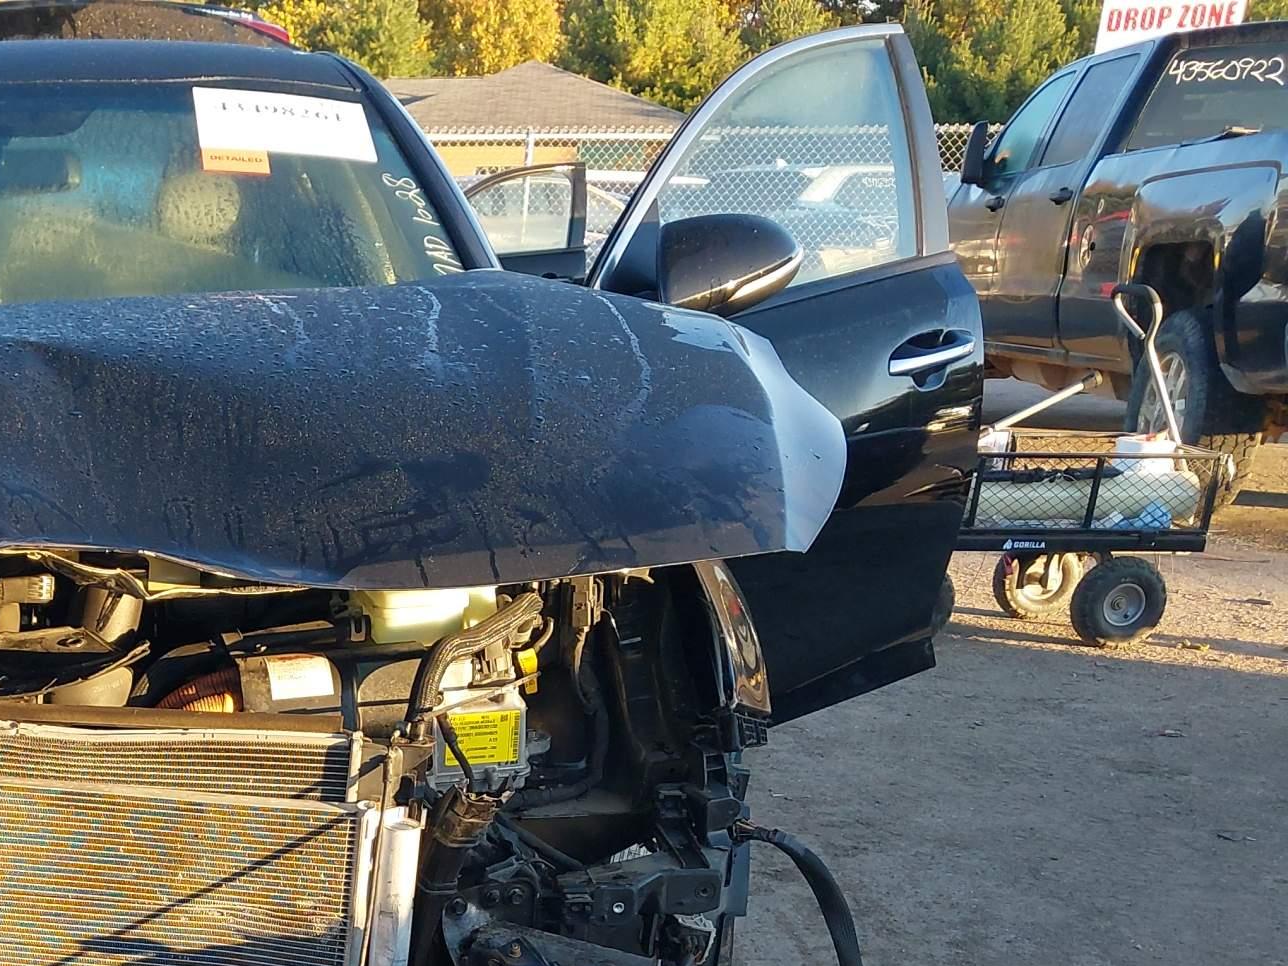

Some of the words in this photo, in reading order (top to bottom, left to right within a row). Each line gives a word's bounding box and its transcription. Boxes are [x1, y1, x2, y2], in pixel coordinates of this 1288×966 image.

[1106, 5, 1173, 33] DROP
[1175, 1, 1239, 29] ZONE
[1168, 56, 1285, 86] 43560922
[208, 154, 264, 164] DETAILED
[1013, 541, 1046, 549] GORILLA
